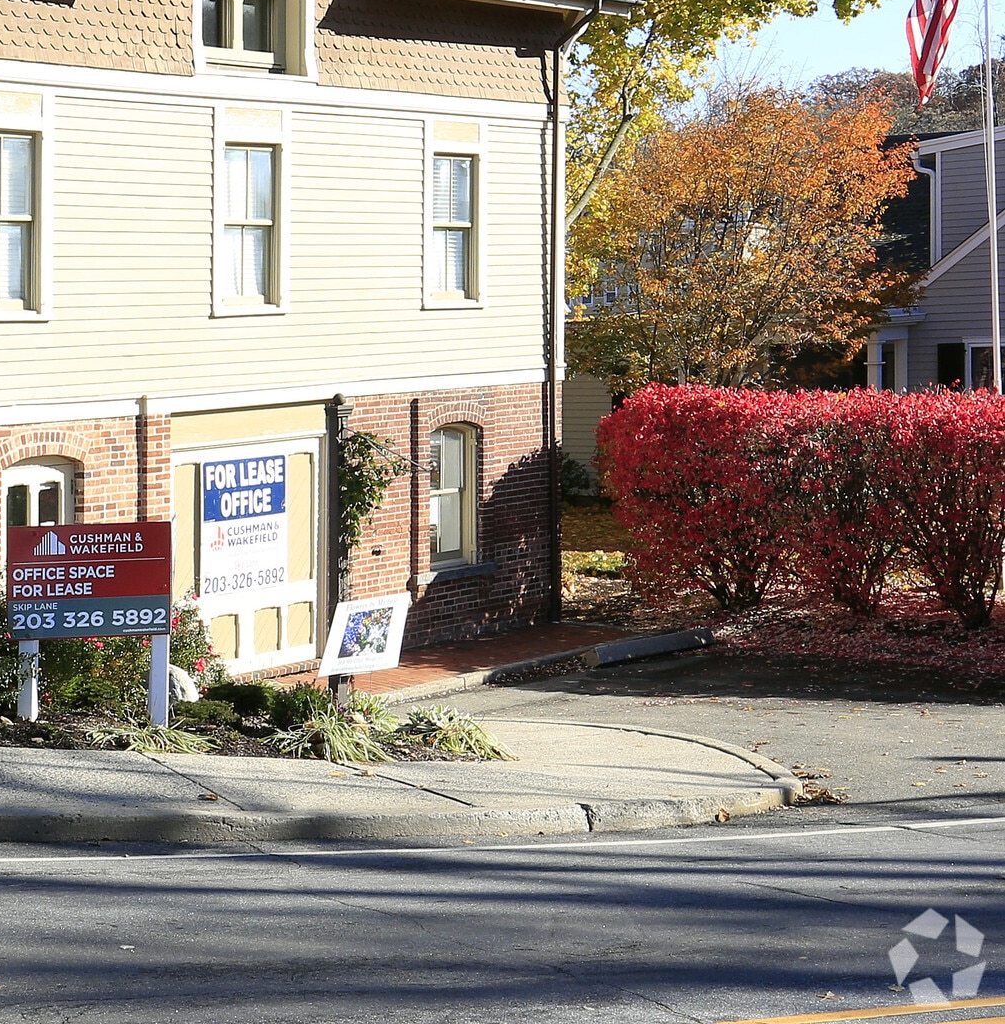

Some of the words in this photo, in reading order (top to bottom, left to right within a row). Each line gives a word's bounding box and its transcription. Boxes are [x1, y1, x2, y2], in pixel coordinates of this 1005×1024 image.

[205, 463, 237, 491] FOR
[239, 458, 284, 487] LEASE
[220, 487, 272, 518] OFFICE
[227, 522, 273, 537] CUSHMAN
[274, 521, 280, 530] &
[69, 532, 131, 544] CUSHMAN
[134, 532, 143, 542] &
[227, 531, 278, 547] WAKEFIELD
[69, 543, 144, 555] WAKEFIELD
[12, 567, 66, 581] OFFICE
[68, 565, 115, 579] SPACE
[204, 566, 285, 594] 203-326-5892
[12, 584, 43, 598] FOR
[46, 582, 93, 597] LEASE
[12, 603, 33, 611] SKIP
[34, 602, 58, 610] LANE
[12, 613, 56, 630] 203
[63, 611, 104, 628] 326
[111, 608, 167, 626] 5892
